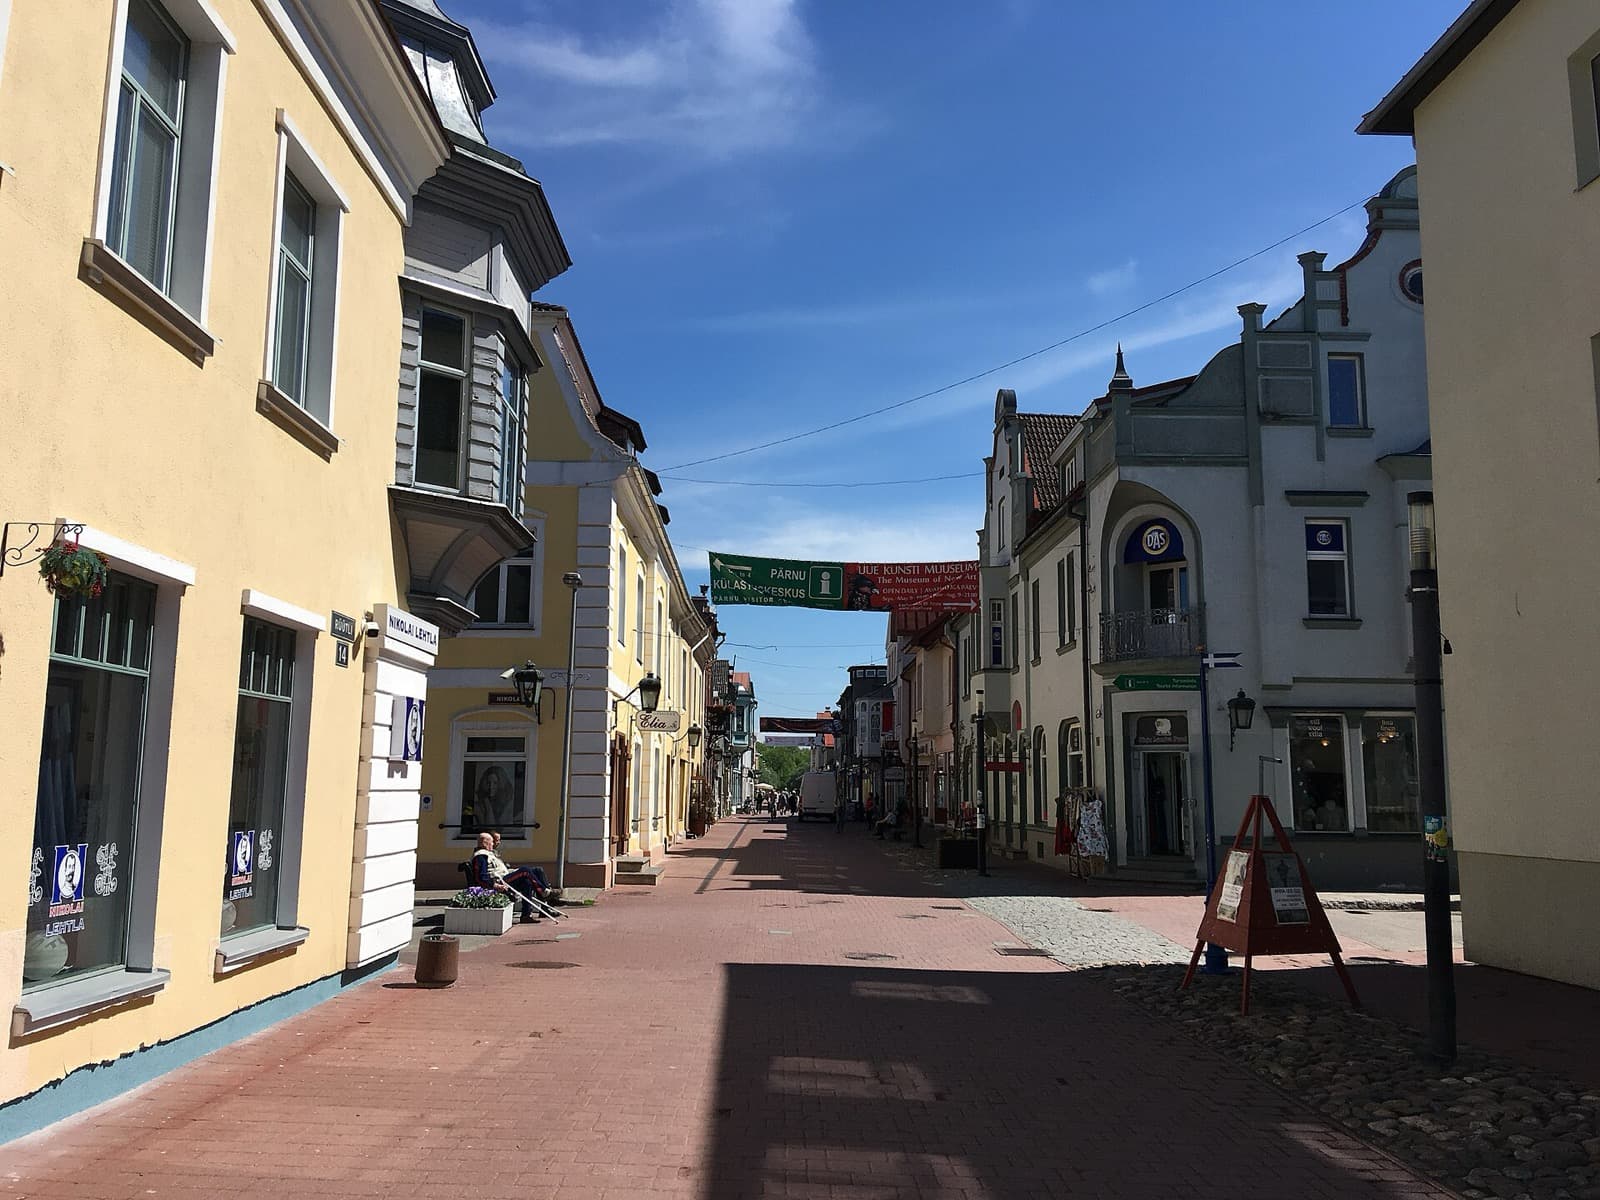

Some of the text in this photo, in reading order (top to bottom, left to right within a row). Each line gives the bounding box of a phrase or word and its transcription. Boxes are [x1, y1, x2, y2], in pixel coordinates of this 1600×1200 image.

[1147, 532, 1166, 549] DAS
[770, 567, 806, 581] PÄRNU
[858, 562, 978, 575] UUE KUNSTI MUUSEUM
[877, 576, 892, 584] The
[895, 576, 930, 584] Museum
[389, 615, 437, 646] NIKOLAI LEHTLA
[337, 645, 347, 663] 14
[639, 713, 667, 729] Elia
[49, 901, 85, 918] NIKOLAI
[45, 917, 85, 937] LEHTLA
